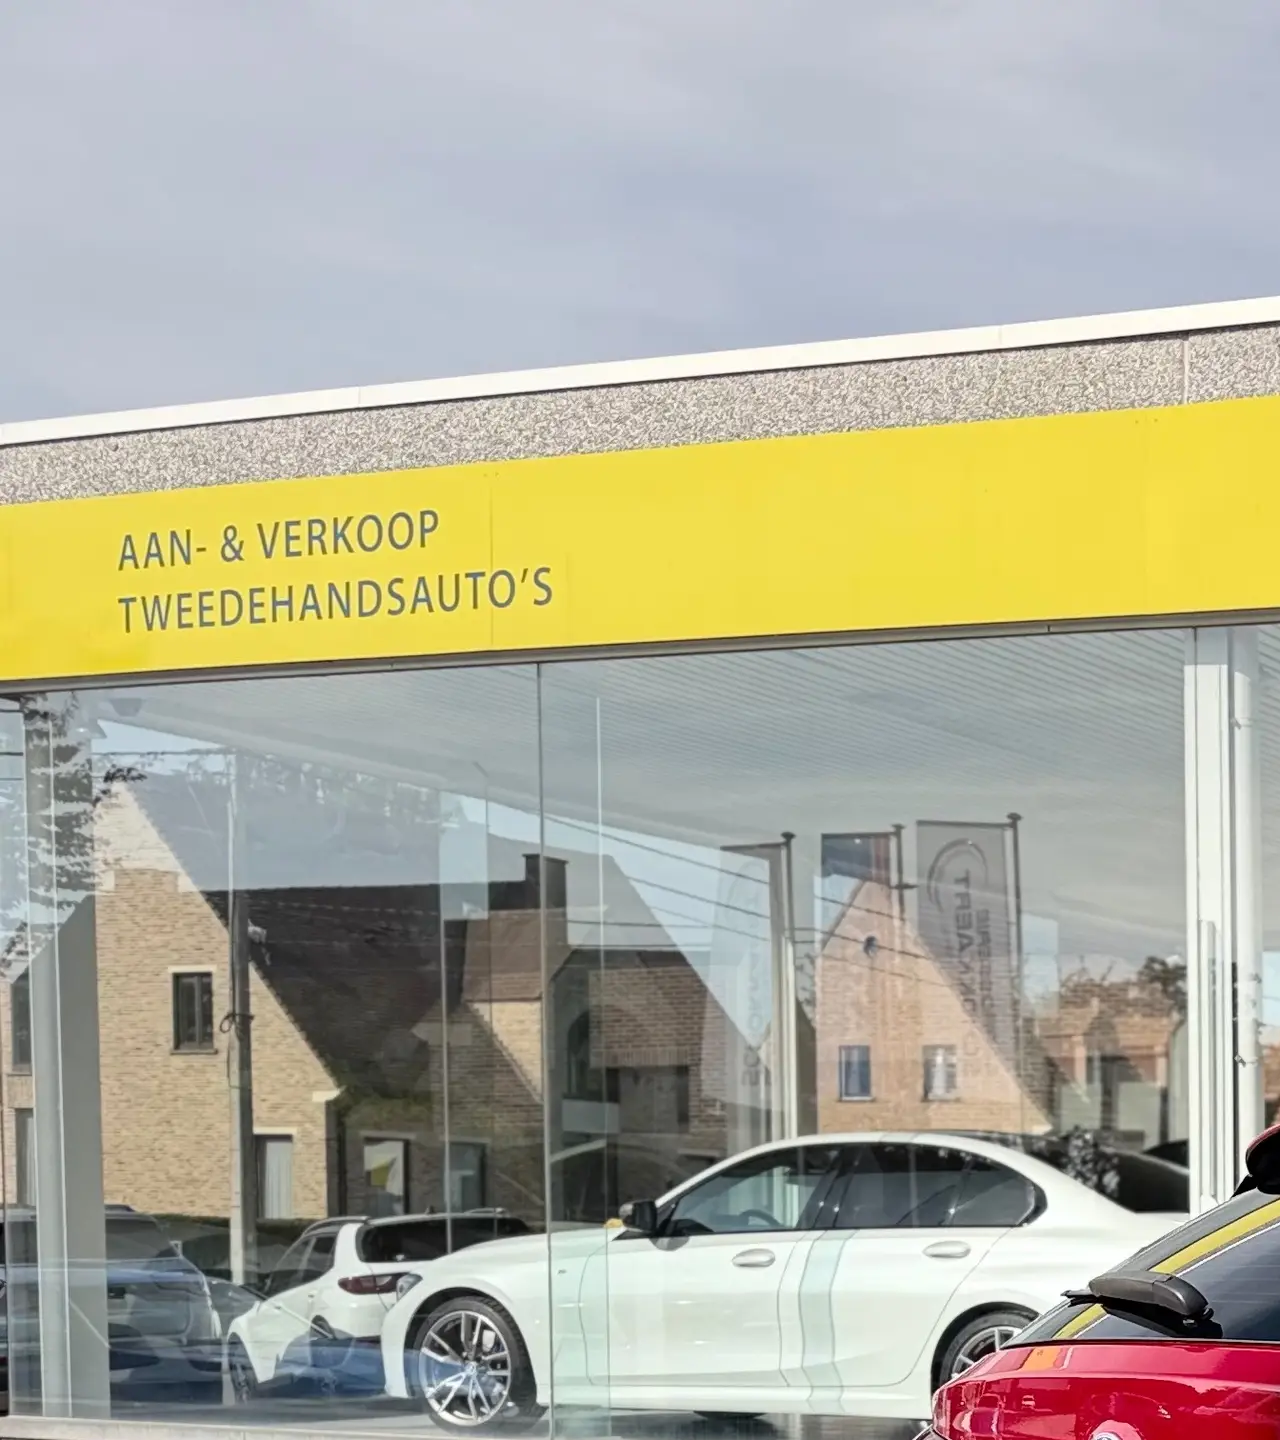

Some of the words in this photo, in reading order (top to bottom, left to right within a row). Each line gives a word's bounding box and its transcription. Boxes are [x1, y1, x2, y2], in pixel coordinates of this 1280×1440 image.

[117, 528, 207, 571] AAN-
[220, 524, 245, 563] &
[256, 509, 439, 560] VERKOOP
[117, 566, 553, 634] TWEEDEHANDSAUTO'S
